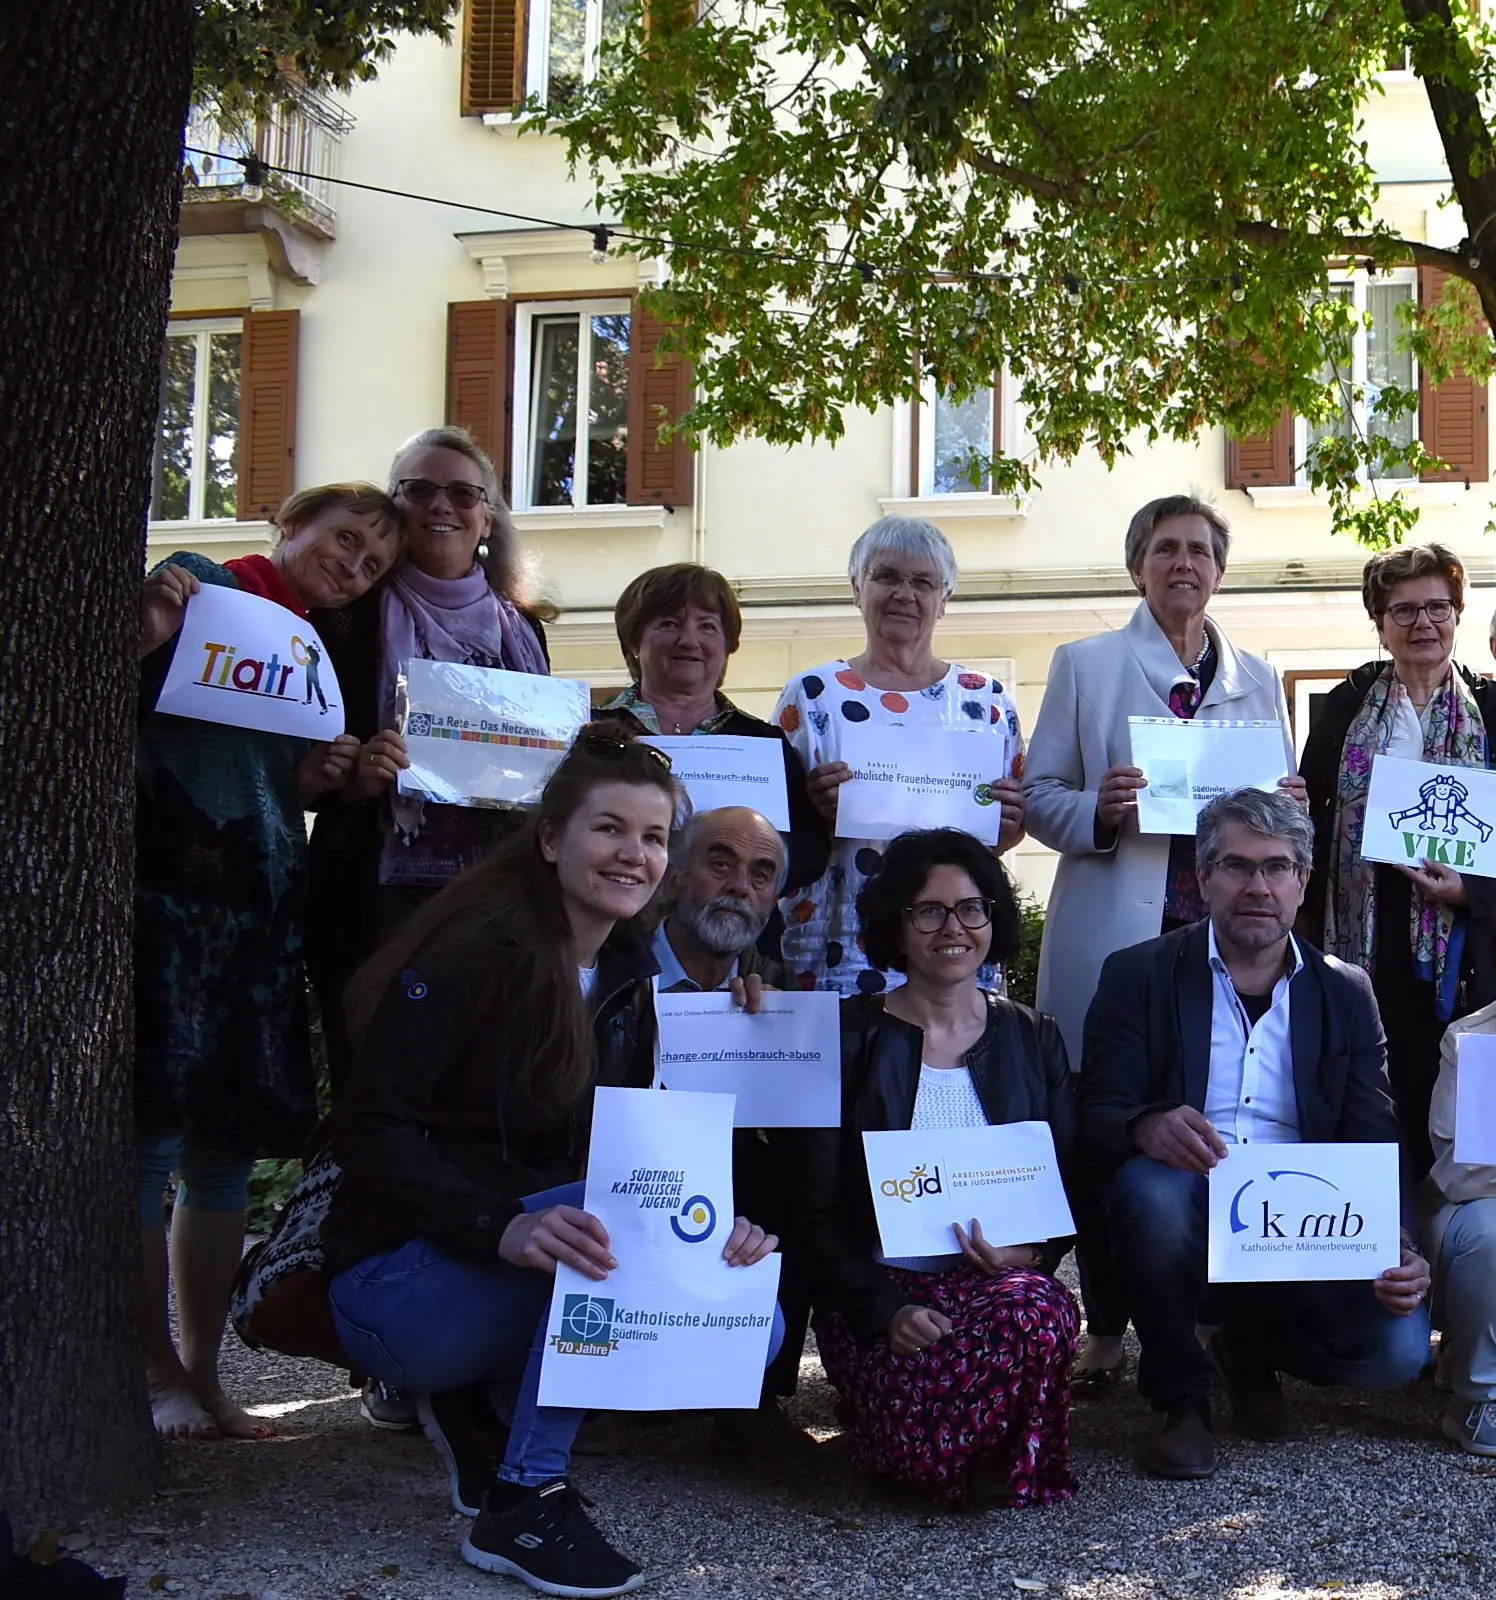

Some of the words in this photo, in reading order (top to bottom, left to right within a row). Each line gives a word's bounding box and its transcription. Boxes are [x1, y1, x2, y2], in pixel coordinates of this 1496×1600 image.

[431, 713, 443, 726] La
[447, 716, 469, 728] Rete
[480, 719, 498, 732] Das
[501, 722, 546, 737] Netzwerk
[854, 769, 894, 782] tholische
[896, 773, 972, 790] Frauenbewegung
[1402, 832, 1477, 868] VKE
[629, 1168, 685, 1183] SÜDTIROLS
[951, 1165, 1048, 1179] ARBEITSGEMEINSCHAFT
[953, 1179, 968, 1188] DER
[970, 1174, 1036, 1187] JUGENDDIENSTE
[611, 1182, 682, 1196] KATHOLISCHE
[639, 1196, 681, 1209] JUGEND
[1240, 1242, 1294, 1253] Katholische
[1295, 1241, 1378, 1253] Männerbewegung
[614, 1308, 700, 1327] Katholische
[702, 1312, 771, 1331] Jungschar
[611, 1328, 658, 1341] Südtirols
[559, 1342, 574, 1354] 70
[575, 1342, 609, 1357] Jahre
